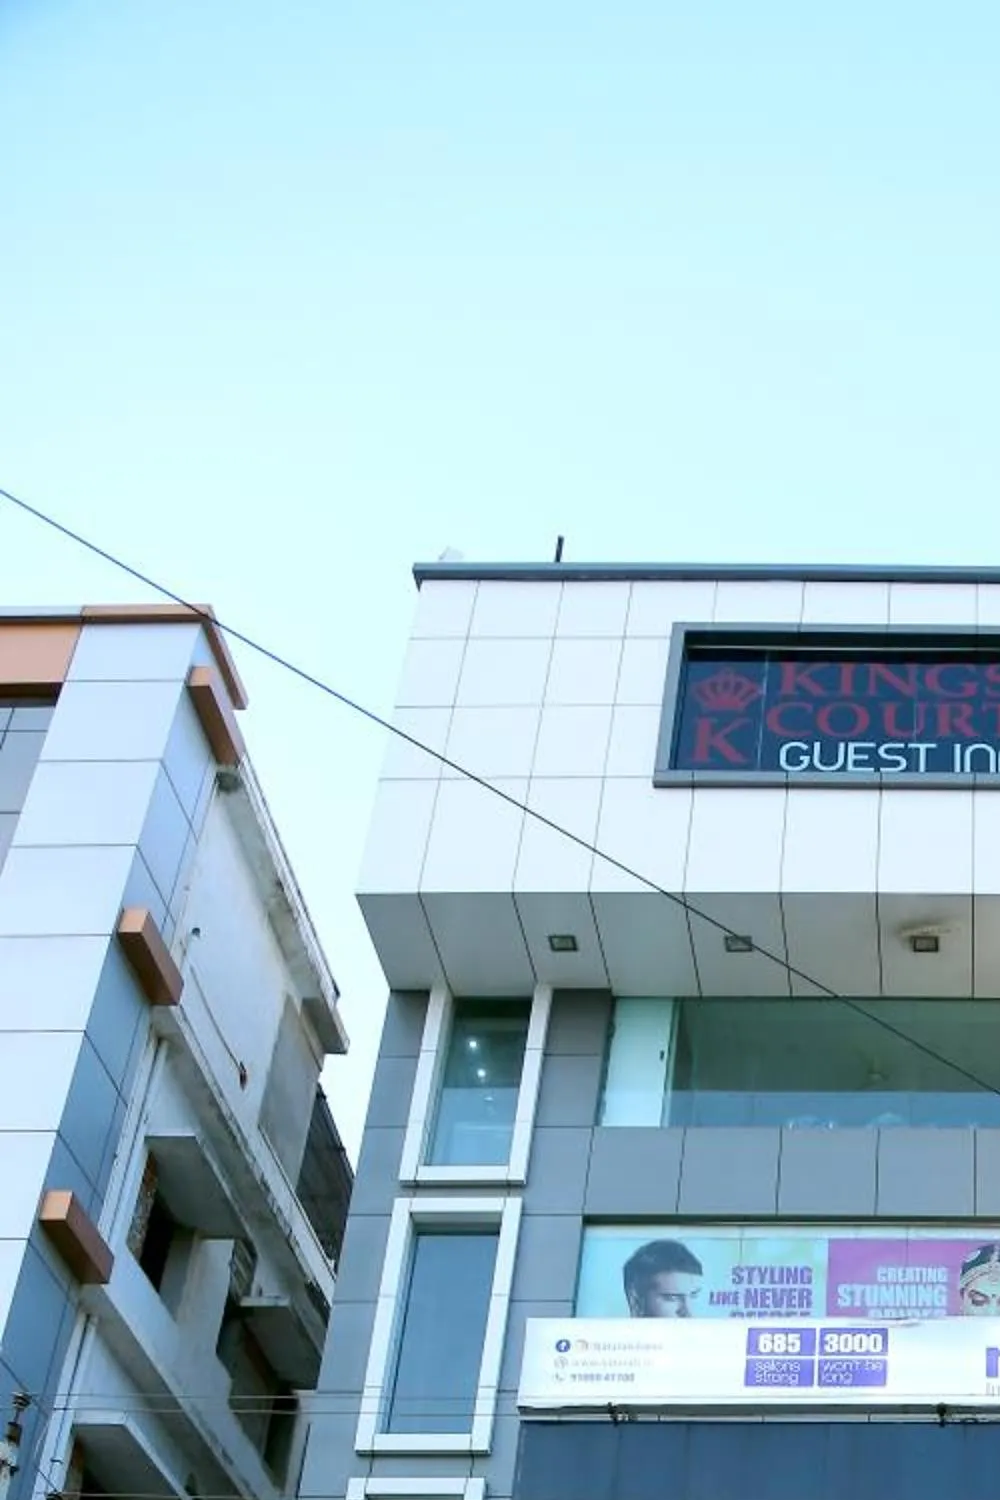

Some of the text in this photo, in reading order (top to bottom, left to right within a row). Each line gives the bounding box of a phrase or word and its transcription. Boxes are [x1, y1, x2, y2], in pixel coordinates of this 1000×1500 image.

[779, 741, 937, 772] GUEST
[731, 1265, 813, 1286] STYLING
[876, 1267, 948, 1283] CREATING
[709, 1288, 813, 1309] LIKE NEVER
[836, 1284, 948, 1307] STUNNING
[758, 1333, 801, 1353] 685
[823, 1333, 883, 1353] 3000
